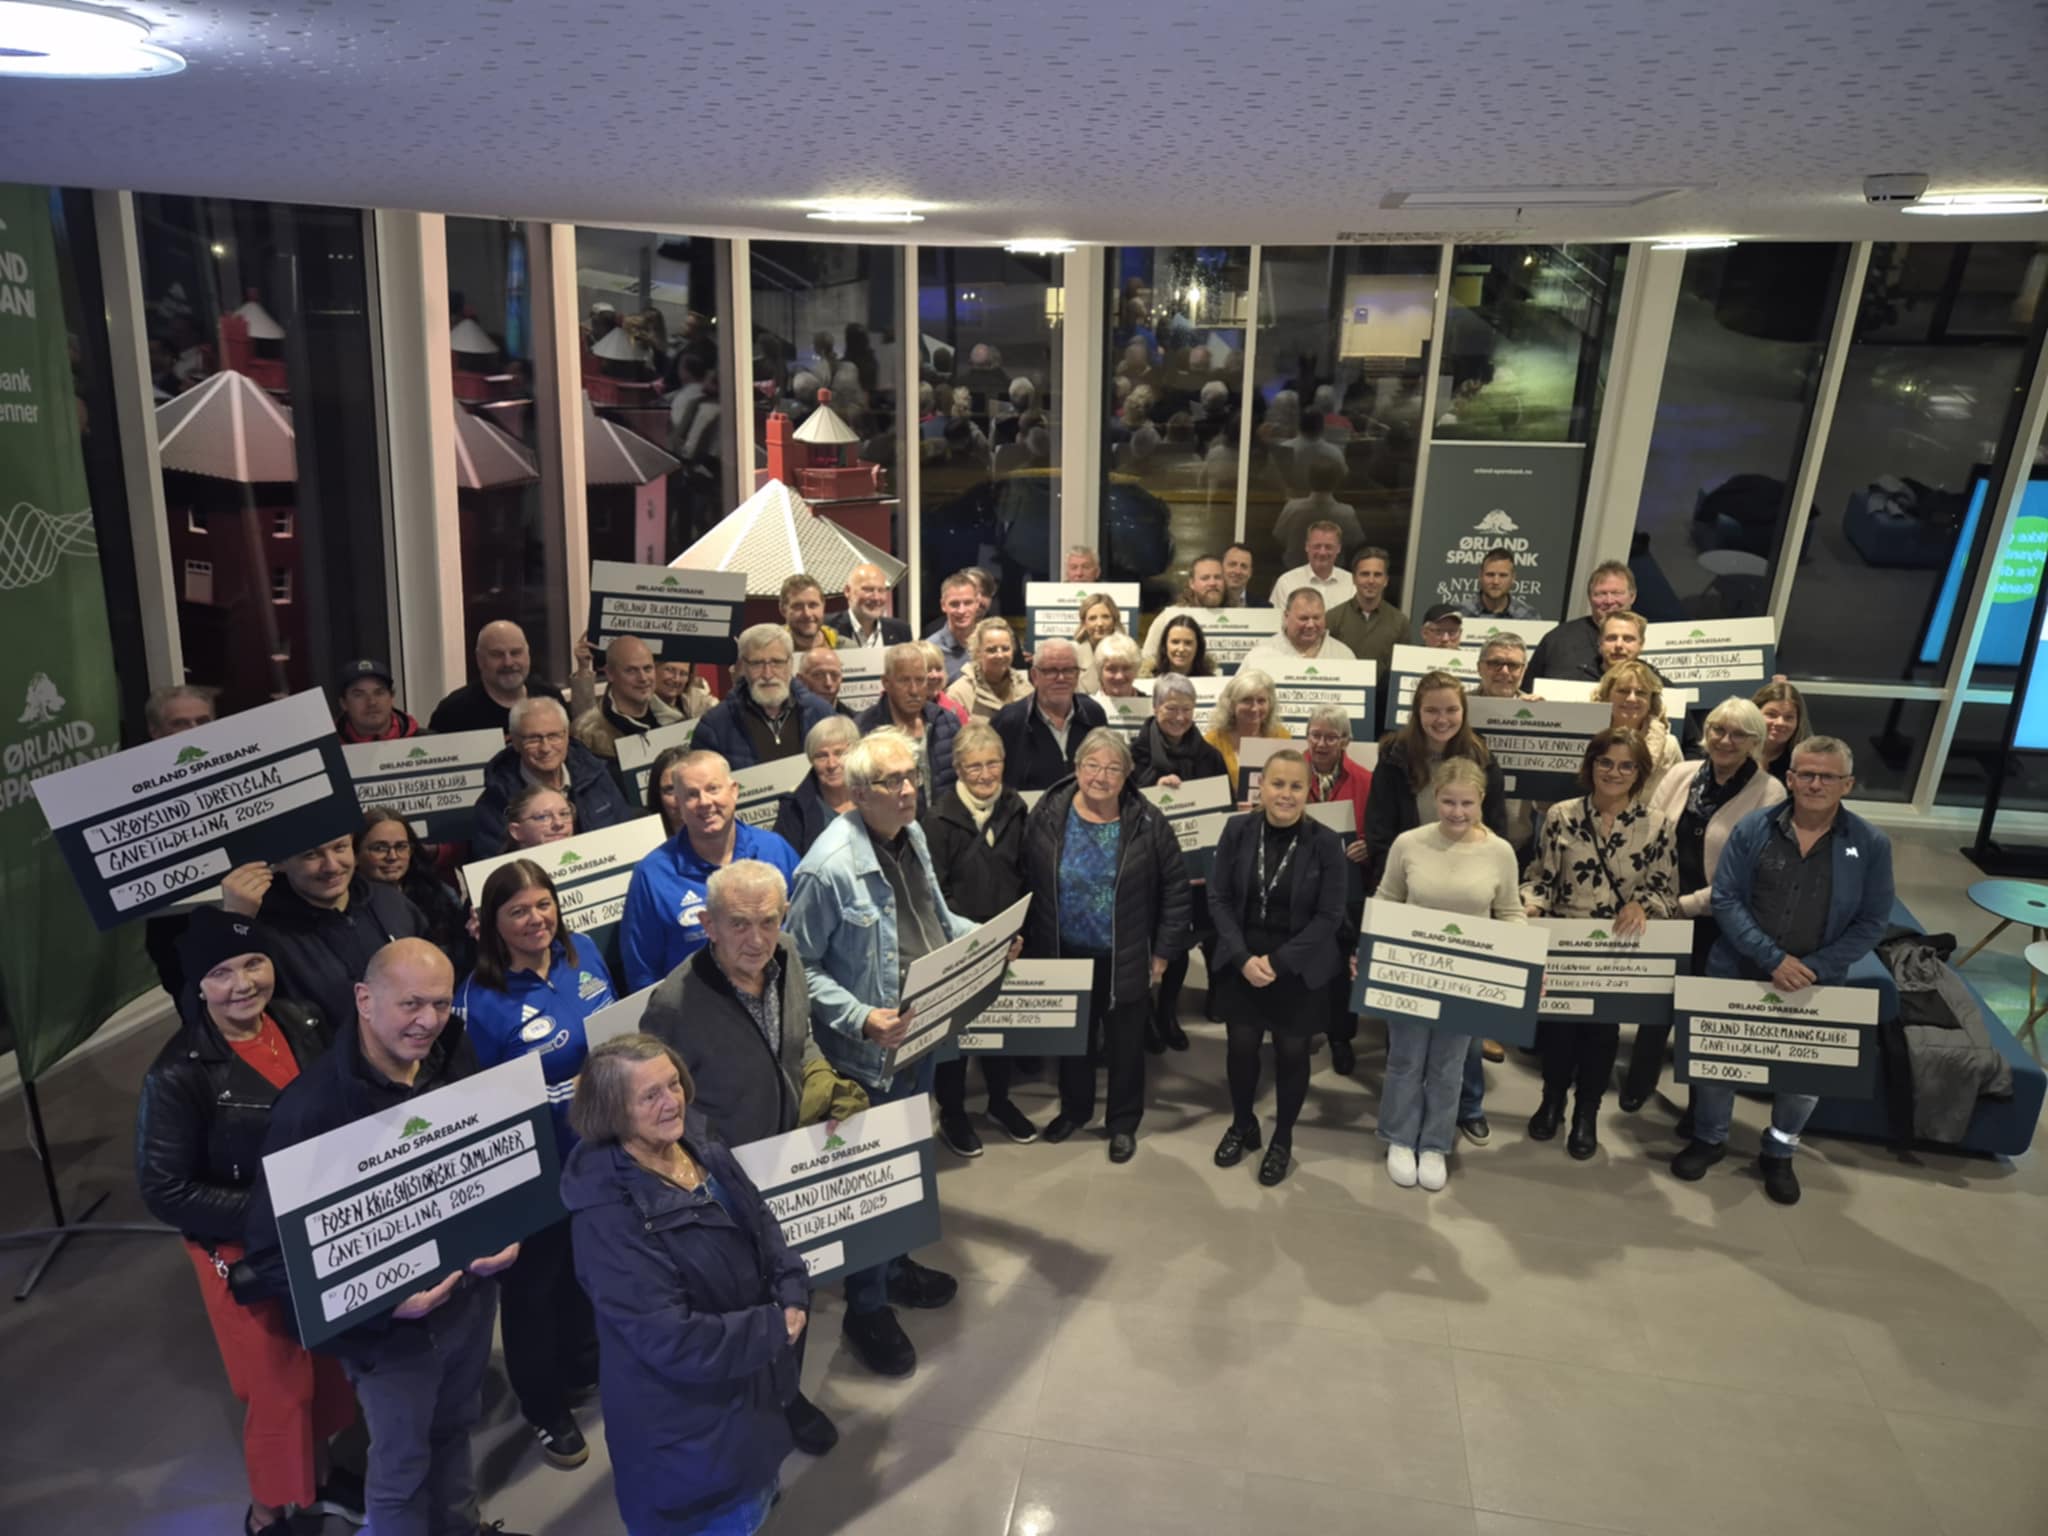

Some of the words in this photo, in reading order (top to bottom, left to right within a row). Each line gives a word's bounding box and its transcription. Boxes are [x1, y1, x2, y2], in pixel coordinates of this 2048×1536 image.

[0, 403, 38, 423] enner
[1459, 536, 1529, 551] ØRLAND
[1446, 550, 1539, 567] SPARNK
[1436, 582, 1449, 595] &
[1451, 577, 1541, 594] NYLDER
[4, 720, 95, 774] ØRLAND
[132, 768, 188, 794] ØRLAND
[189, 743, 261, 775] SPAREBANK
[378, 760, 414, 771] ØRLAND
[414, 754, 460, 766] SPAREBANK
[1547, 758, 1577, 770] 2025
[99, 799, 192, 845] LYSØYSUND
[196, 766, 283, 811] IDRETTSLAG
[437, 794, 462, 806] 2025
[108, 818, 230, 871] GAVETILDELING
[236, 799, 275, 822] 2025
[548, 867, 568, 879] AND
[568, 854, 617, 874] SPAREBANK
[128, 881, 157, 904] 30
[560, 889, 584, 908] AND
[1412, 930, 1446, 942] ØRLAND
[1446, 936, 1494, 951] SPAREBANK
[1388, 947, 1400, 962] IL
[1408, 952, 1455, 972] YRJAR
[1377, 966, 1472, 996] GAVETILDELING
[1476, 984, 1508, 1002] 2025
[1376, 994, 1392, 1007] 20
[1540, 1001, 1548, 1009] 0
[1728, 1002, 1766, 1012] ØRLAND
[1766, 1004, 1820, 1016] SPAREBANK
[1700, 1019, 1740, 1034] ØRLAND
[1788, 1046, 1819, 1059] 2025
[1700, 1064, 1718, 1076] 50
[357, 1143, 412, 1173] ØRLAND
[412, 1114, 480, 1150] SPAREBANK
[790, 1154, 830, 1174] ØRLAND
[830, 1140, 880, 1162] SPAREBANK
[320, 1196, 364, 1237] FOSEN
[459, 1130, 526, 1176] SAMLINGER
[768, 1186, 820, 1217] ØRLAND
[820, 1164, 894, 1202] UNGDOMSLAG
[328, 1202, 442, 1268] GAVETILDELING
[449, 1182, 486, 1210] 2025
[784, 1204, 855, 1243] VETILDELING
[860, 1194, 888, 1216] 2025
[343, 1282, 368, 1314] 20
